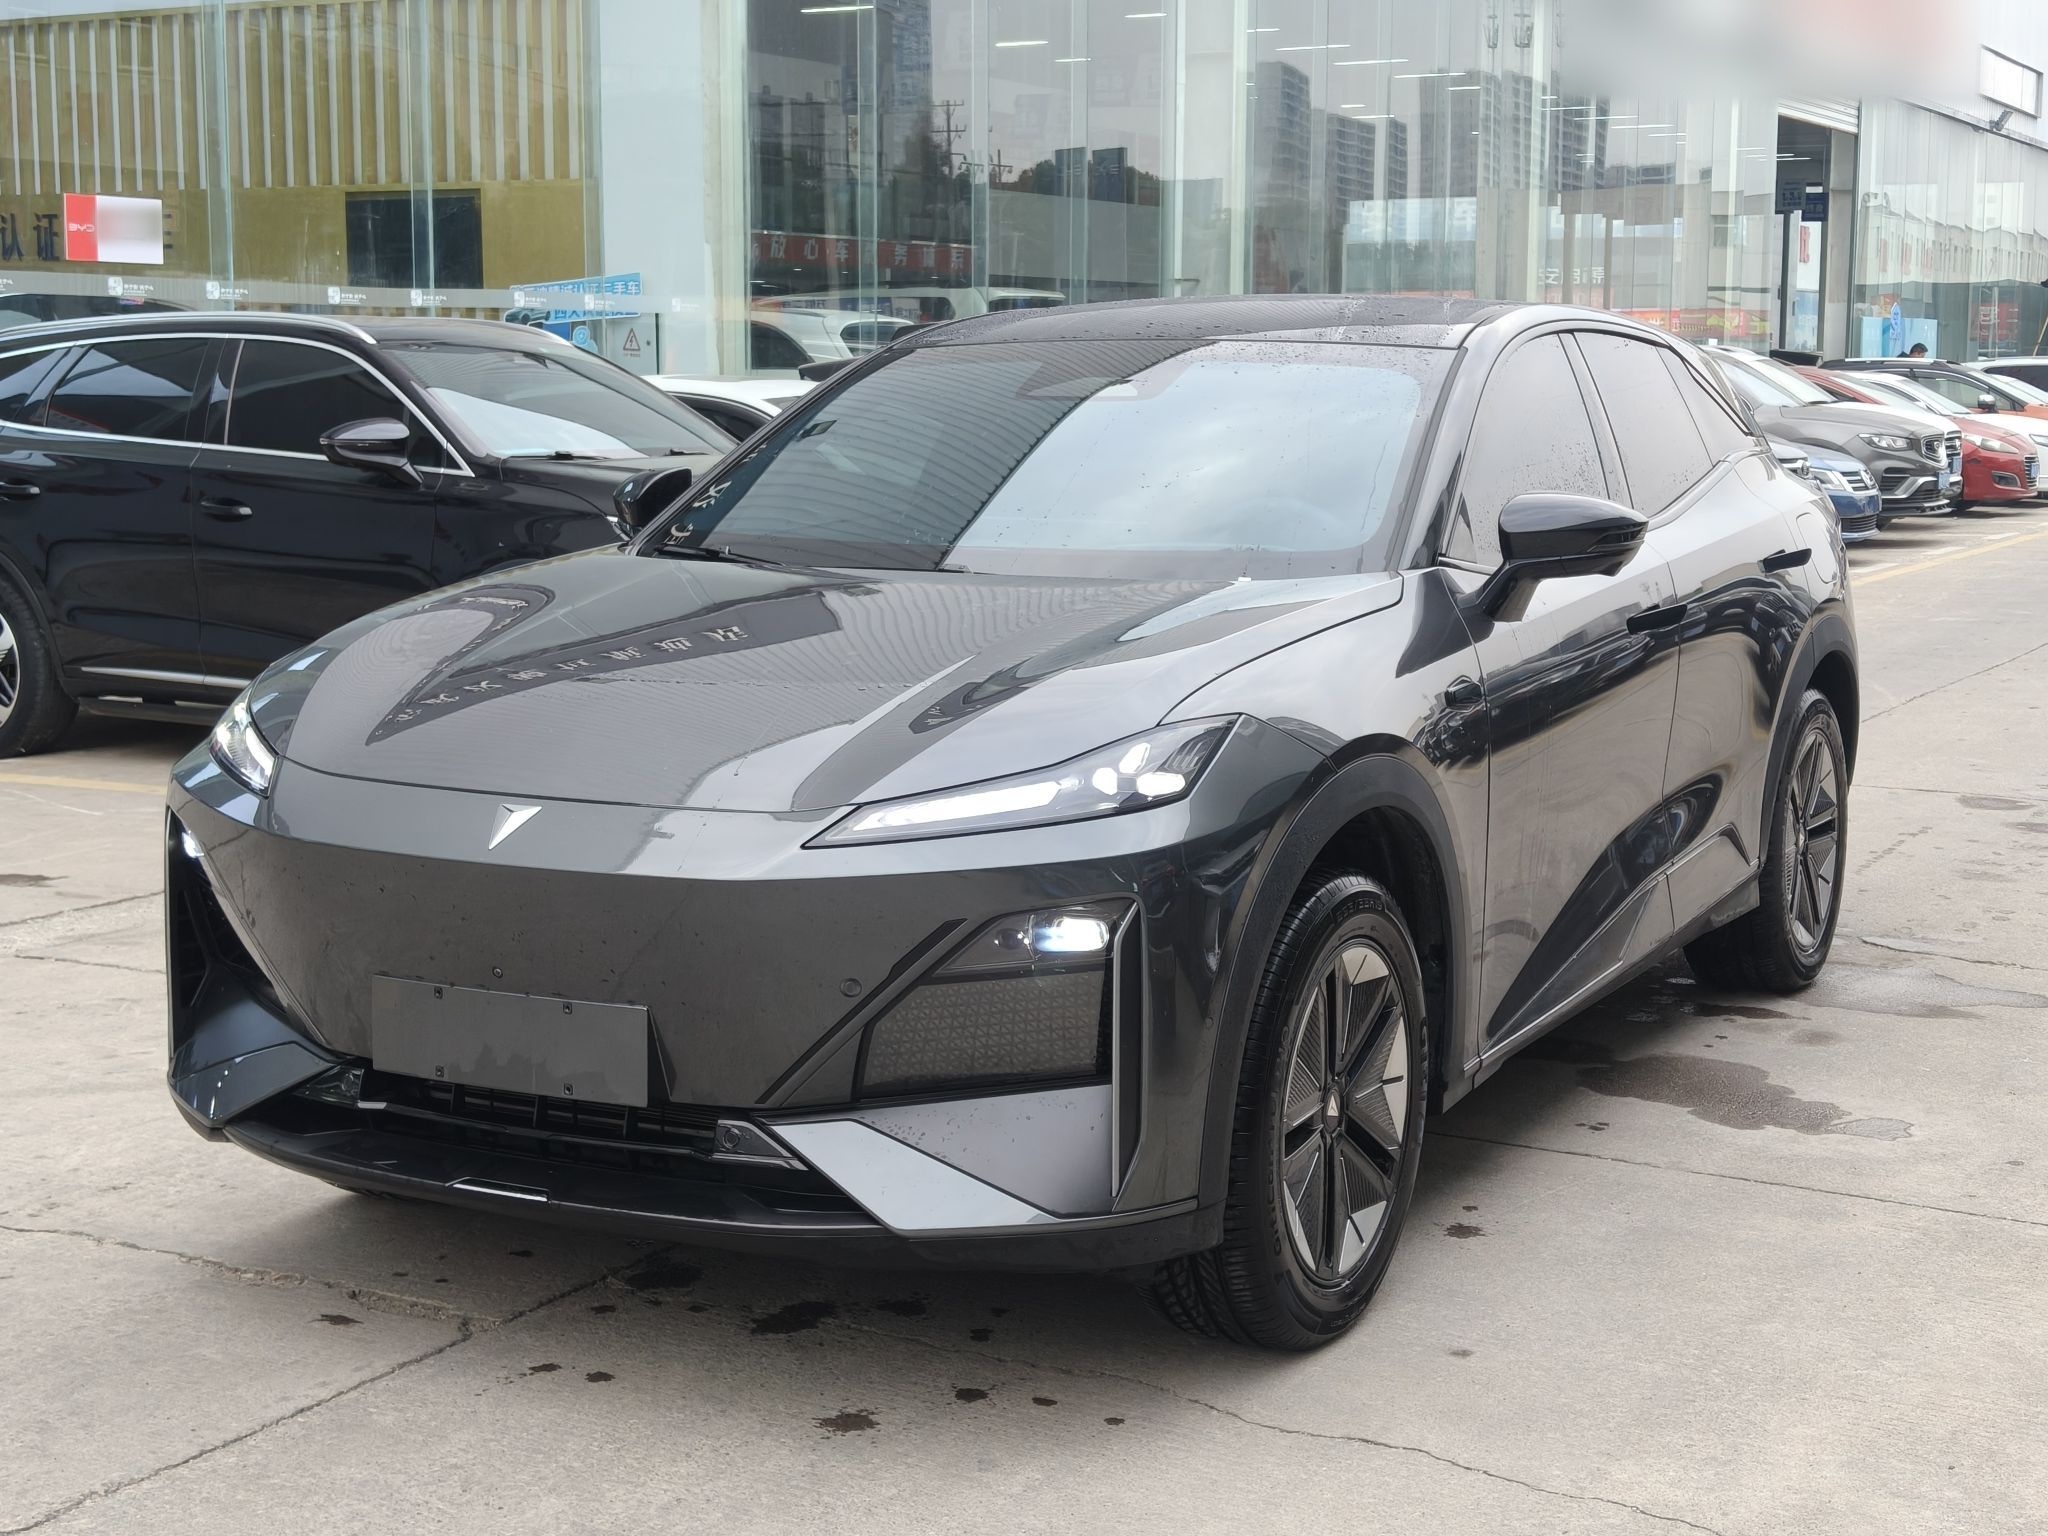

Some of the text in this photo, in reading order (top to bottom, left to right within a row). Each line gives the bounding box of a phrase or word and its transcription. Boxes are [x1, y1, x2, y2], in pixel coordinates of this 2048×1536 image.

[68, 222, 96, 233] BYD
[0, 213, 61, 262] 认证
[512, 280, 640, 296] 迪精诚认证二手车
